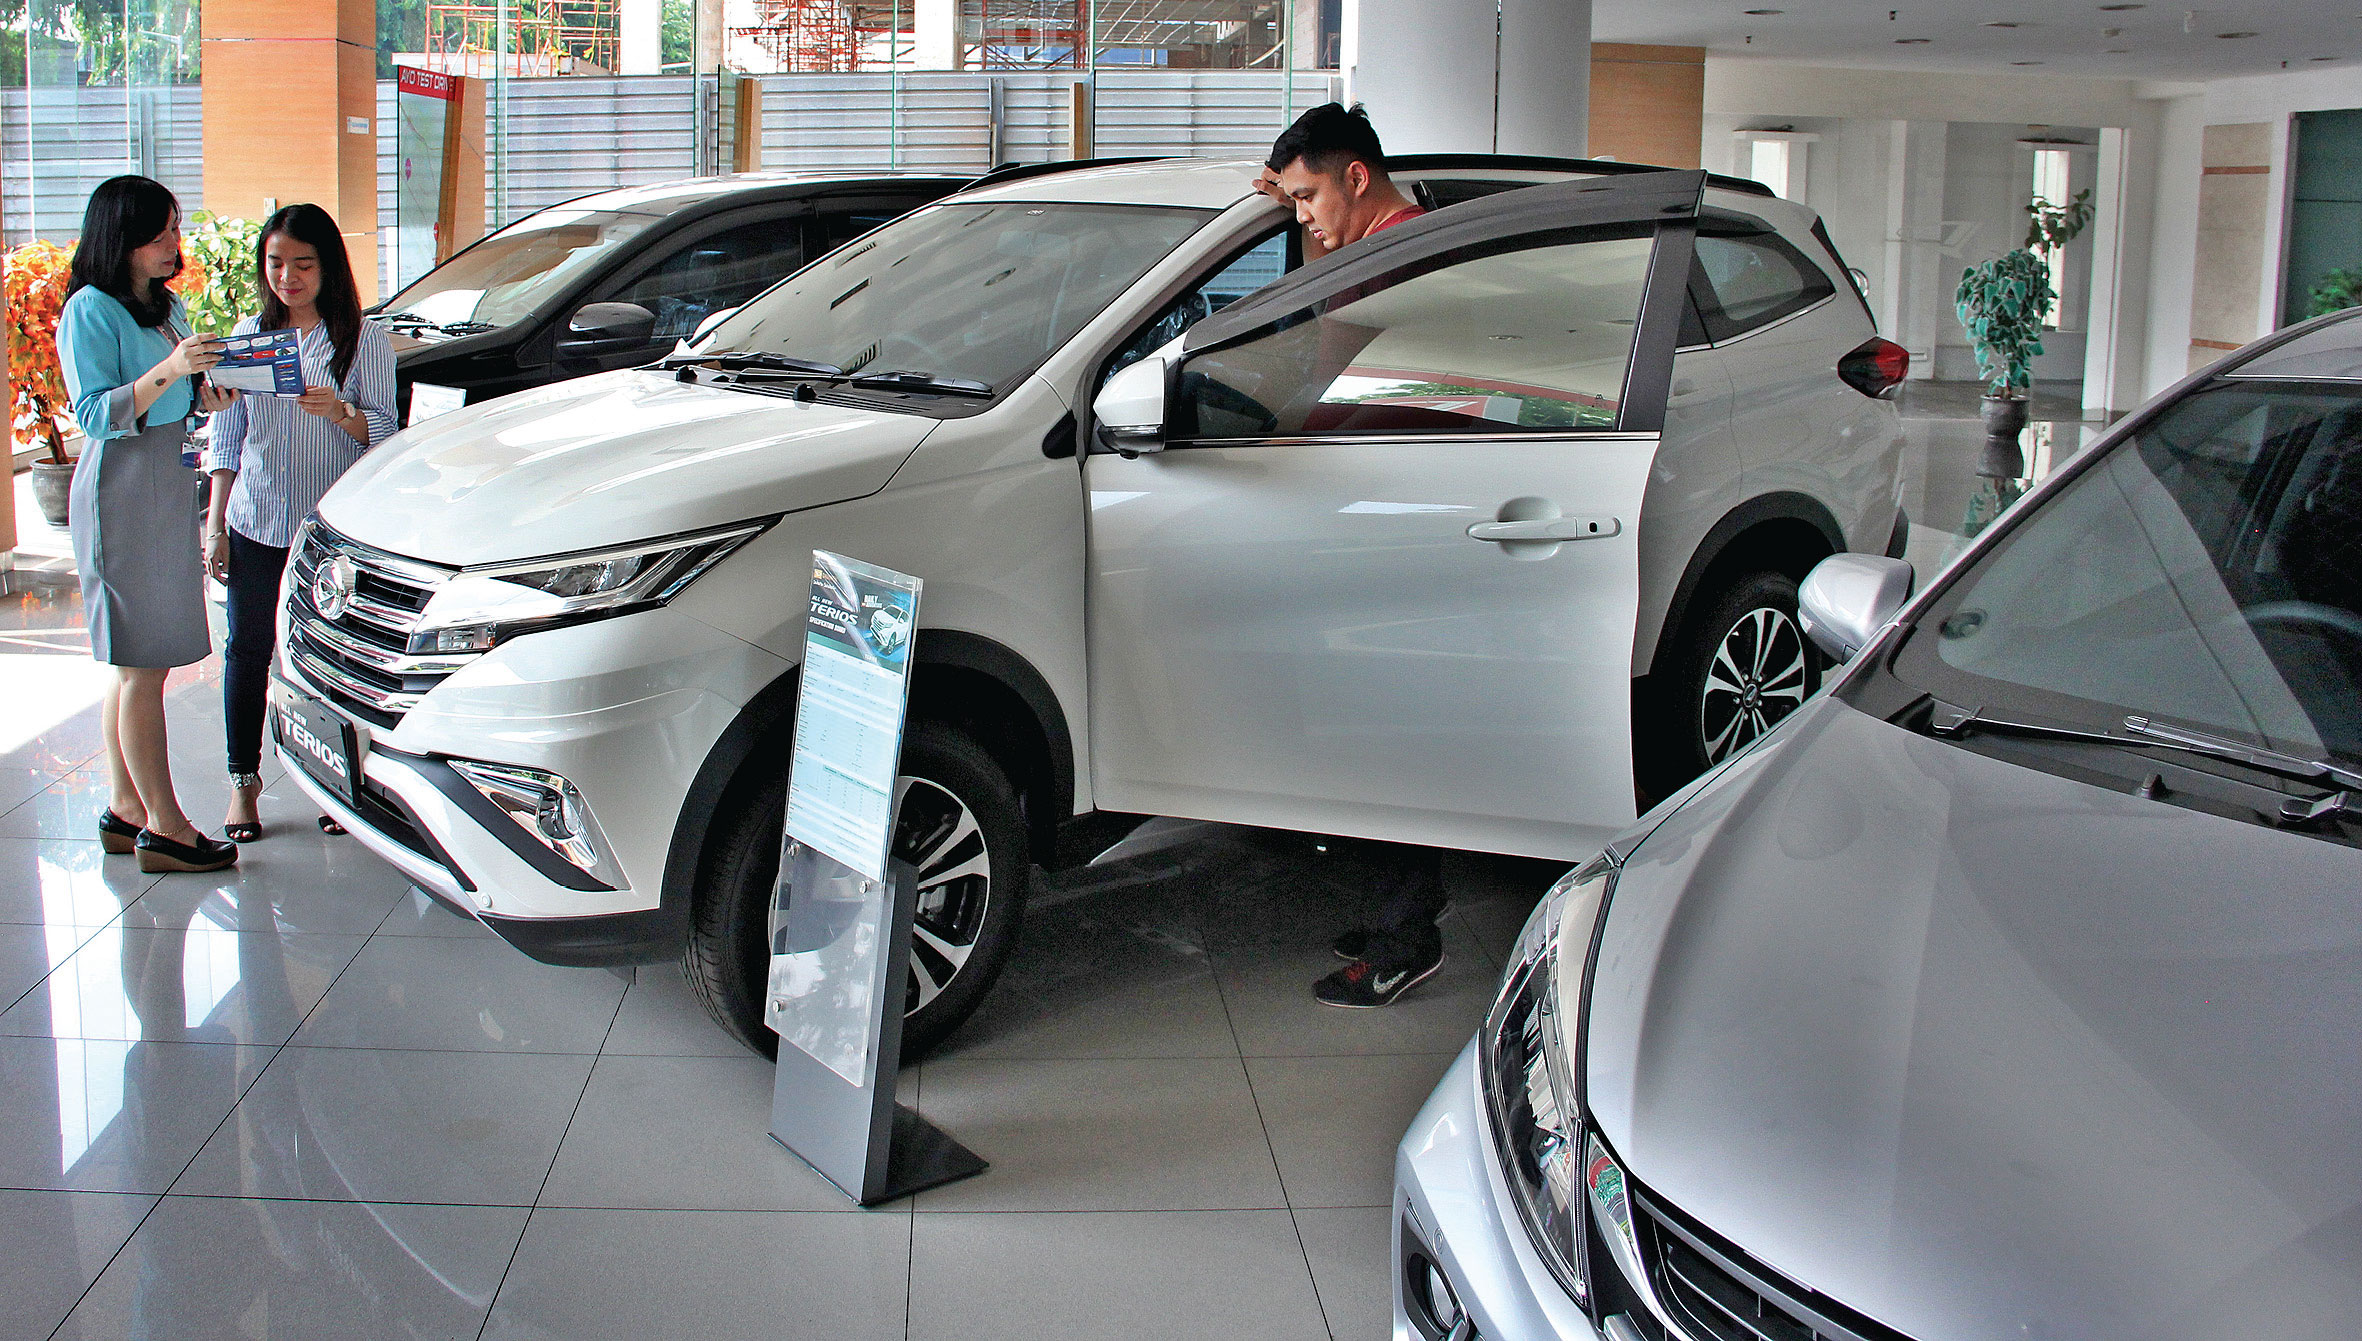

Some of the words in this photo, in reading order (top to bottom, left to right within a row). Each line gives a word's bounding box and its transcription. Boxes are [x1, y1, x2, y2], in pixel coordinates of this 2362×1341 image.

[400, 67, 415, 85] AYO
[417, 71, 434, 88] TEST
[810, 601, 858, 626] TERIOS
[281, 702, 291, 716] ALL
[293, 710, 307, 726] NEW
[281, 713, 346, 778] TERIOS
